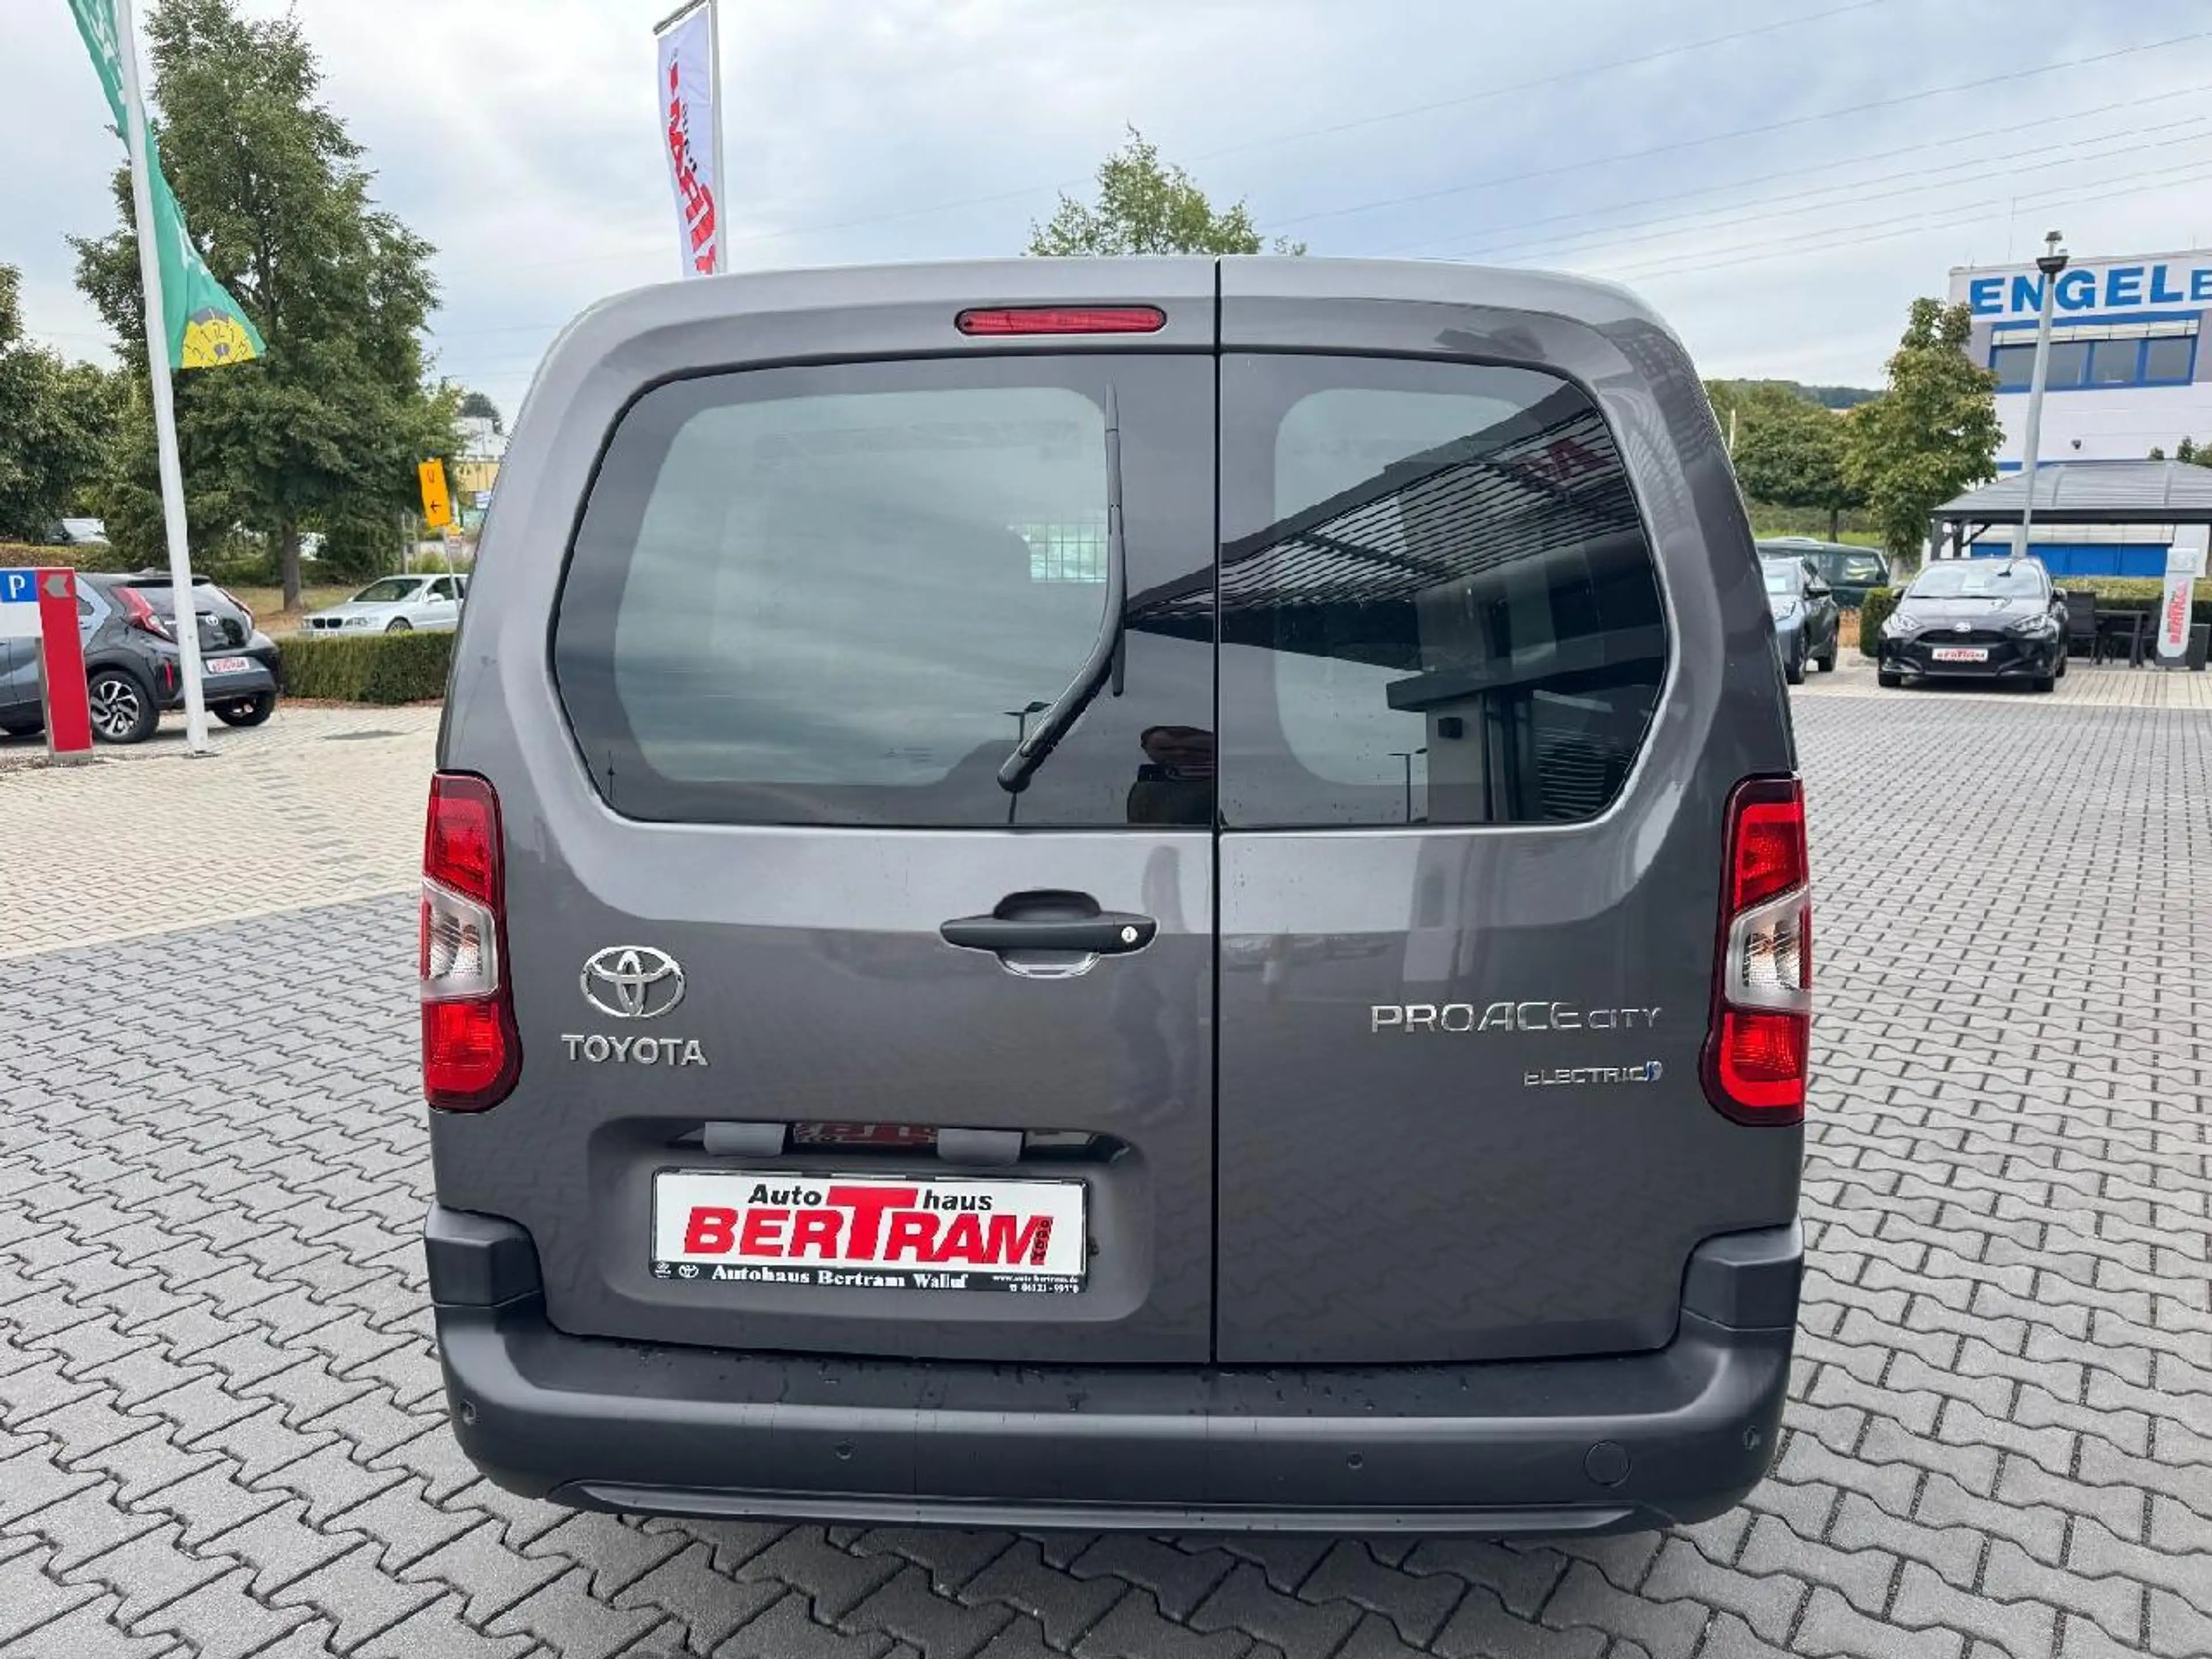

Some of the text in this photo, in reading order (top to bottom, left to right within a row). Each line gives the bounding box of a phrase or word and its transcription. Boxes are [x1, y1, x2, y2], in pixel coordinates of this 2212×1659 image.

[9, 575, 25, 600] P
[1370, 1001, 1662, 1033] PROACE CITY
[561, 1034, 708, 1066] TOYOTA
[1524, 1065, 1648, 1086] ELECTRIC
[748, 1183, 993, 1211] Auto haus
[683, 1185, 1054, 1266] BERTRAM
[712, 1264, 969, 1289] Autohaus Bertram Walluf
